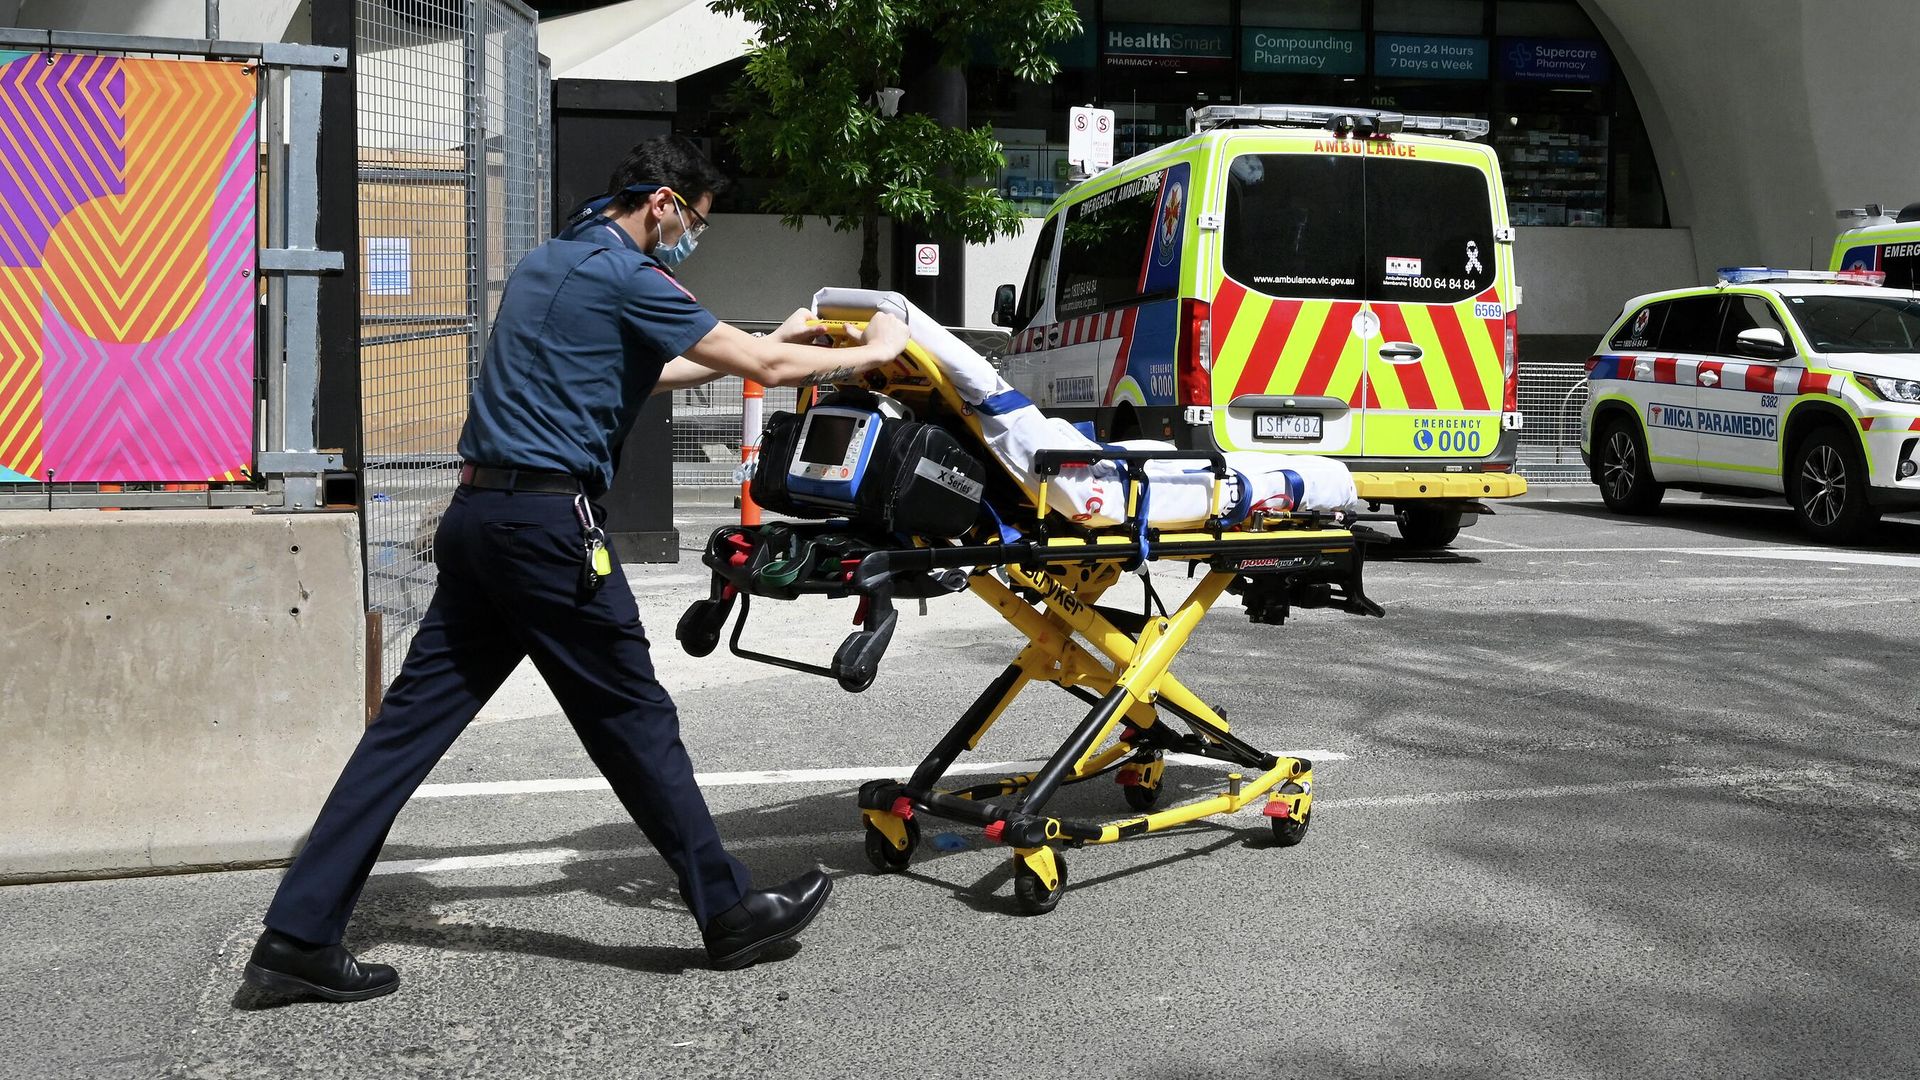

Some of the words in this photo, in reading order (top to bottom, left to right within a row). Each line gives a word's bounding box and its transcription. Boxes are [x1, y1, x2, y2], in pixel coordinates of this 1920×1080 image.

[1108, 31, 1221, 51] HealthSmart
[1255, 33, 1353, 53] Compounding
[1390, 43, 1420, 54] Open
[1423, 44, 1438, 54] 24
[1440, 45, 1474, 56] Hours
[1535, 46, 1597, 59] Supercare
[1107, 58, 1153, 66] PHARMACY
[1254, 50, 1326, 69] Pharmacy
[1390, 58, 1397, 67] 7
[1400, 59, 1429, 70] Days
[1441, 60, 1473, 70] Week
[1536, 58, 1587, 70] Pharmacy
[1314, 140, 1416, 157] AMBULANCE
[1080, 188, 1118, 217] EMERGENCY
[1253, 276, 1355, 287] www.ambulance.vic.gov.au
[1408, 277, 1432, 289] 1800
[1434, 278, 1446, 289] 64
[1449, 279, 1461, 290] 84
[1463, 280, 1476, 290] 84
[1475, 304, 1502, 317] 6569
[1150, 364, 1173, 374] EMERGENCY
[1057, 379, 1094, 401] PARAMEDIC
[1158, 375, 1173, 396] 000
[1761, 395, 1778, 408] 6382
[1414, 419, 1480, 428] EMERGENCY
[1664, 408, 1694, 429] MICA
[1698, 412, 1775, 438] PARAMEDIC
[1439, 431, 1480, 452] 000
[938, 470, 948, 481] X
[947, 475, 971, 494] Series
